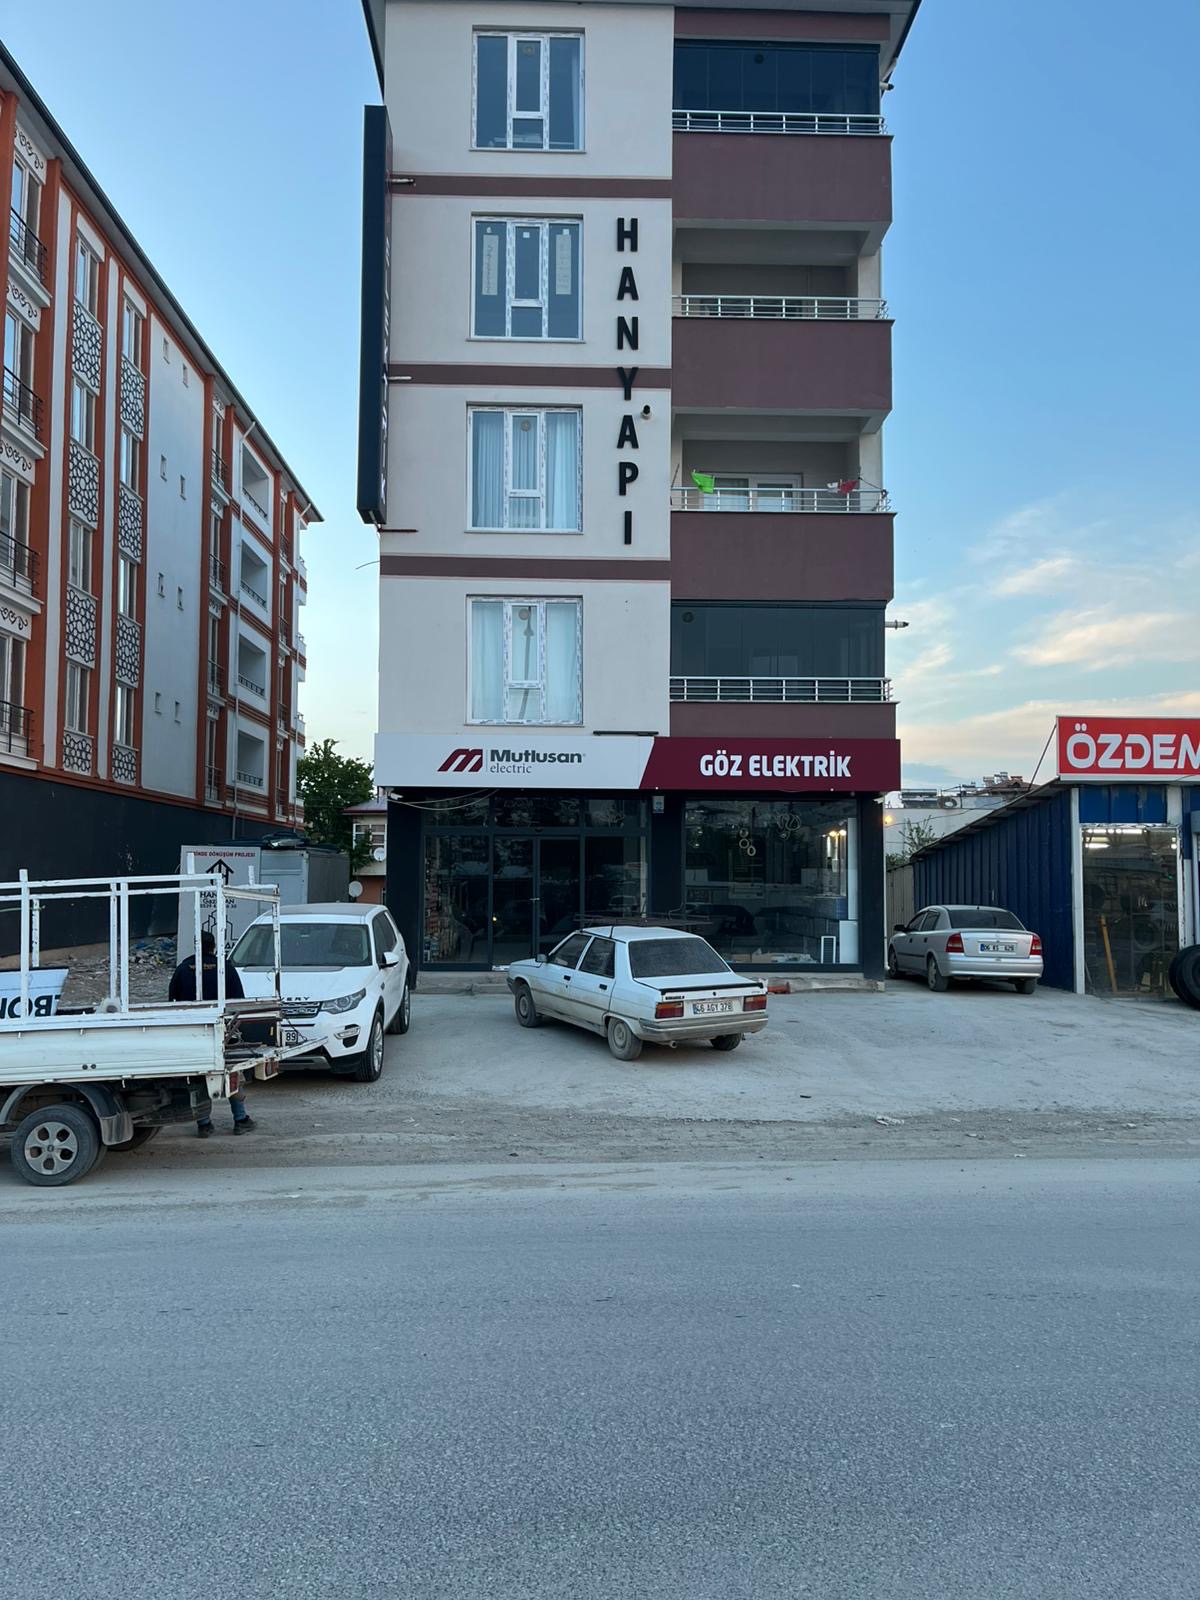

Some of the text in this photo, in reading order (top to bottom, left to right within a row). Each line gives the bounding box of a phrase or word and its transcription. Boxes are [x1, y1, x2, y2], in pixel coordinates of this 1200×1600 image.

[616, 217, 639, 545] HANYAPI
[490, 748, 582, 763] Mutlusan
[700, 749, 852, 777] GÖZ ELEKTRİK
[490, 763, 532, 774] electric
